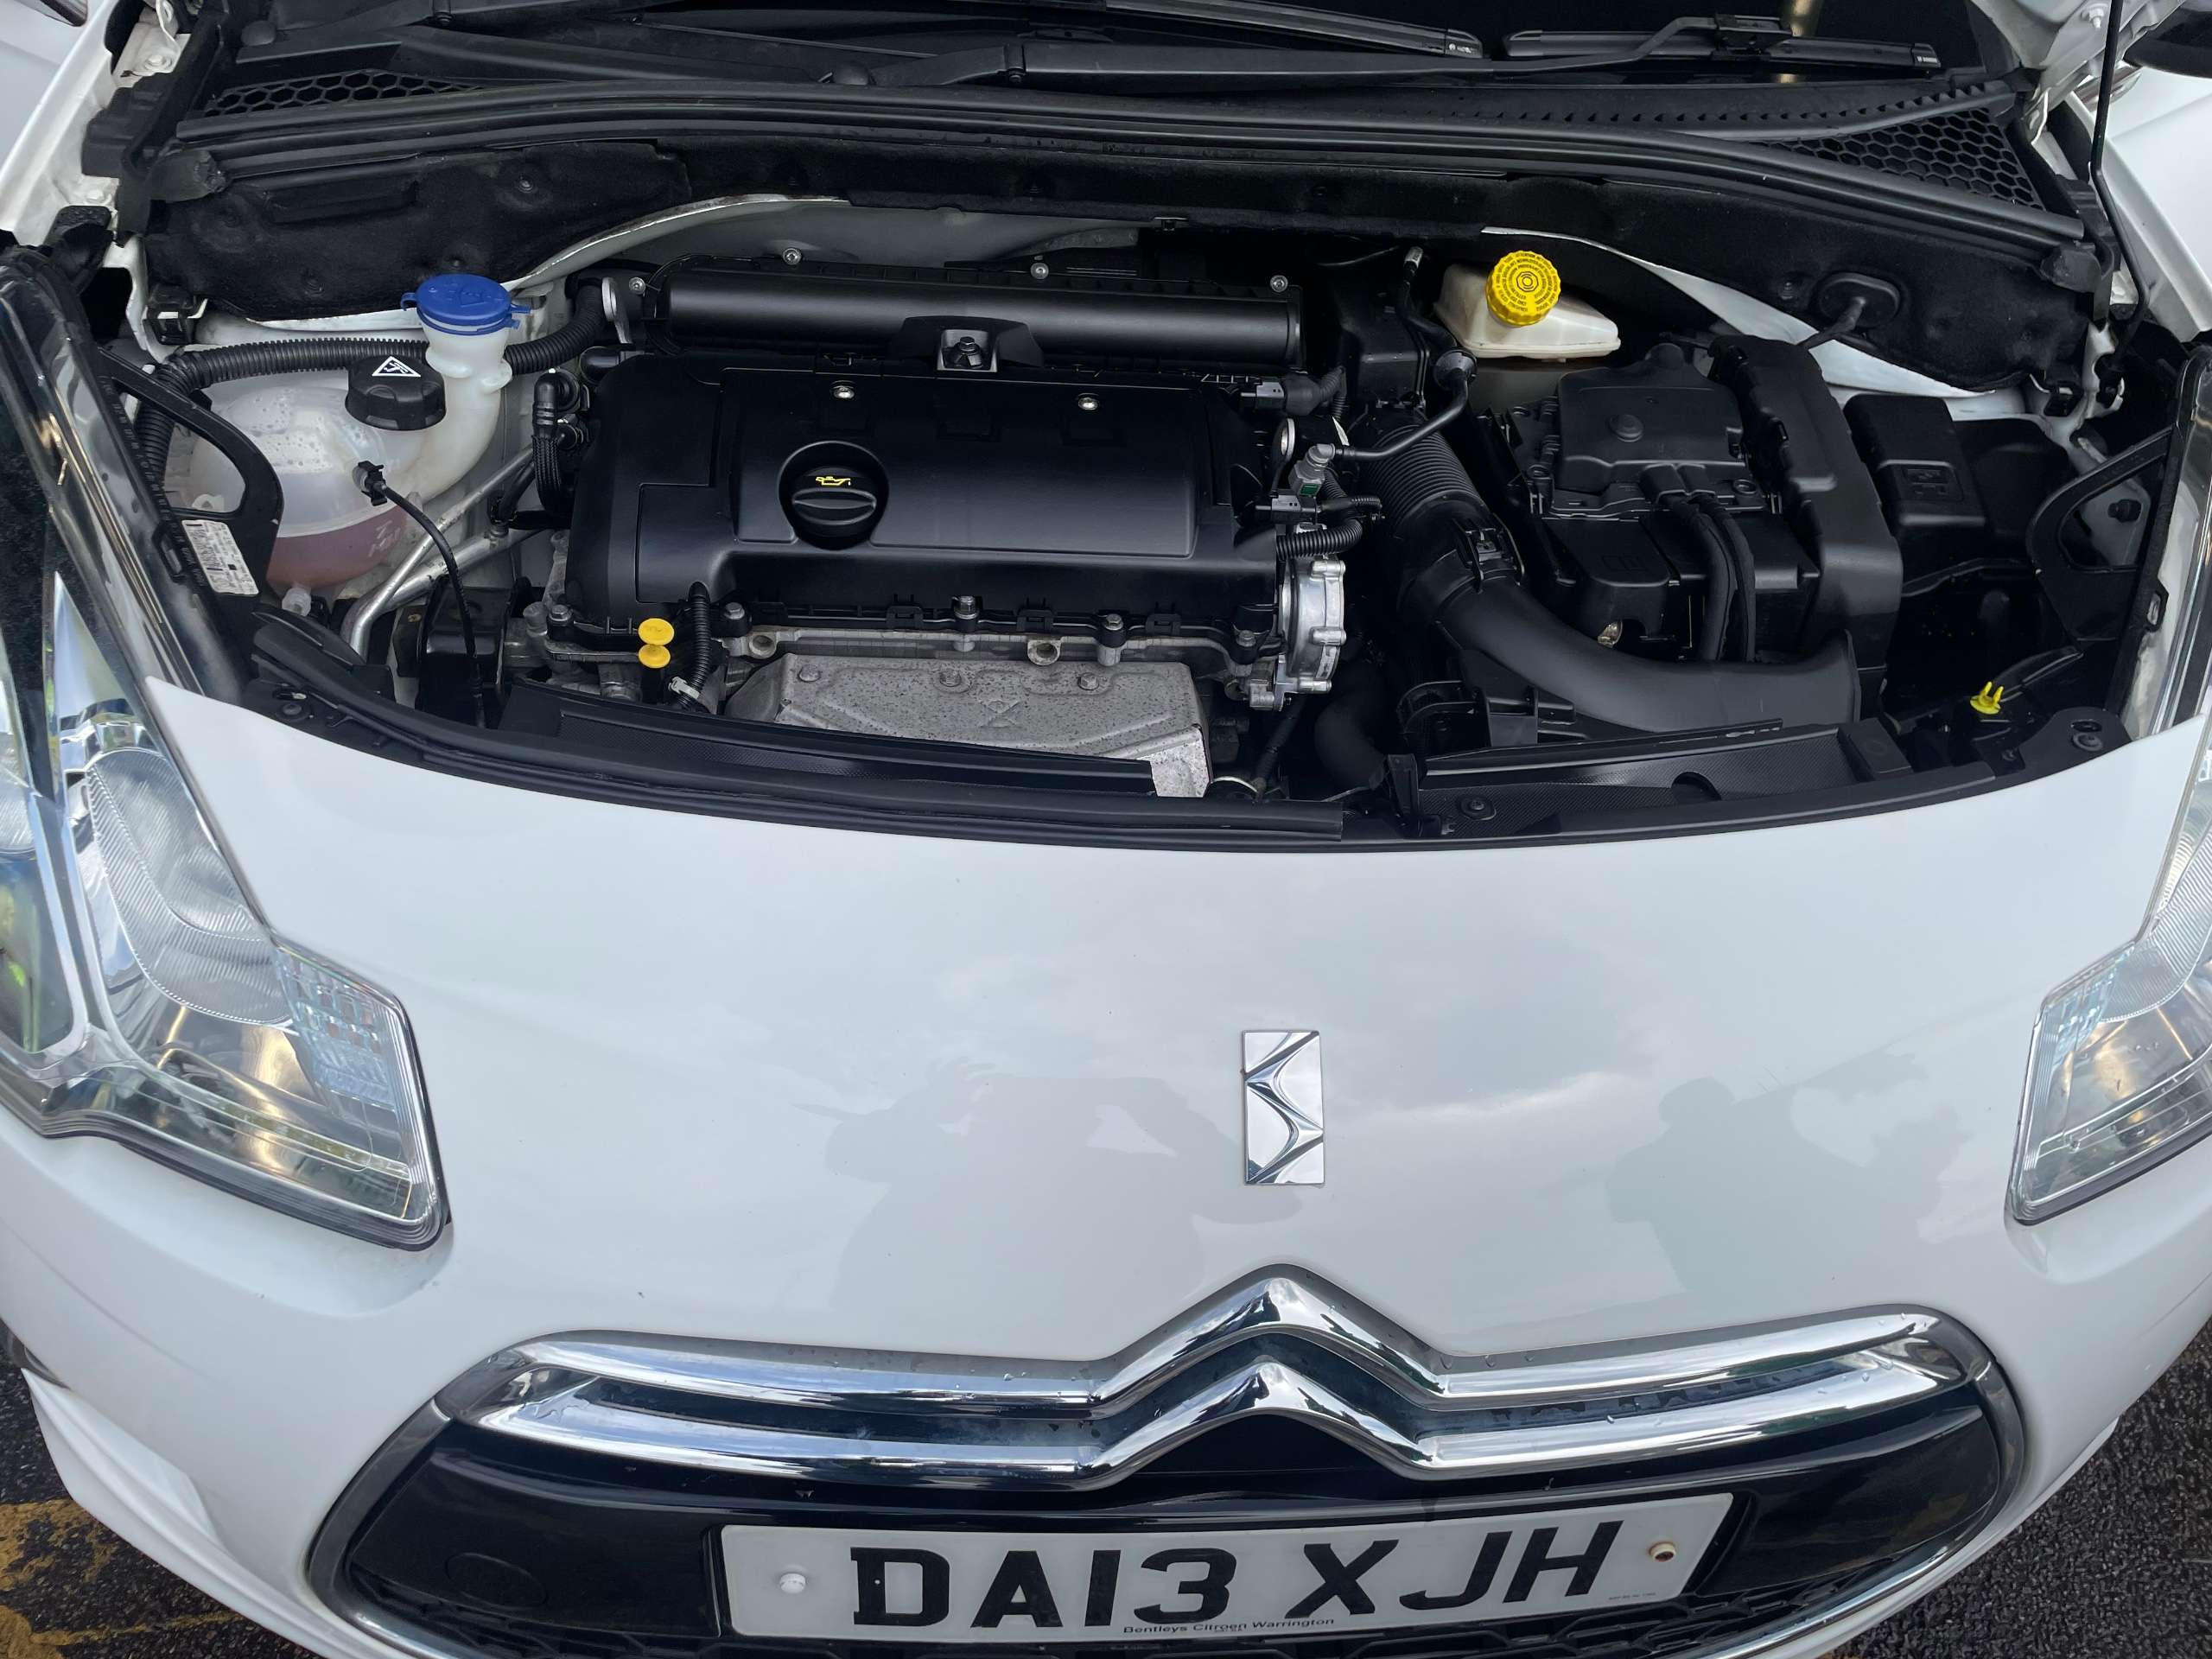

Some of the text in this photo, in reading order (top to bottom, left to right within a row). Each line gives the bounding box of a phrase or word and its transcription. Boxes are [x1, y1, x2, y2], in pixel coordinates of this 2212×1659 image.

[850, 1520, 1624, 1629] DA13 XJH
[1123, 1625, 1187, 1634] Bentleys
[1253, 1618, 1334, 1629] Warrington
